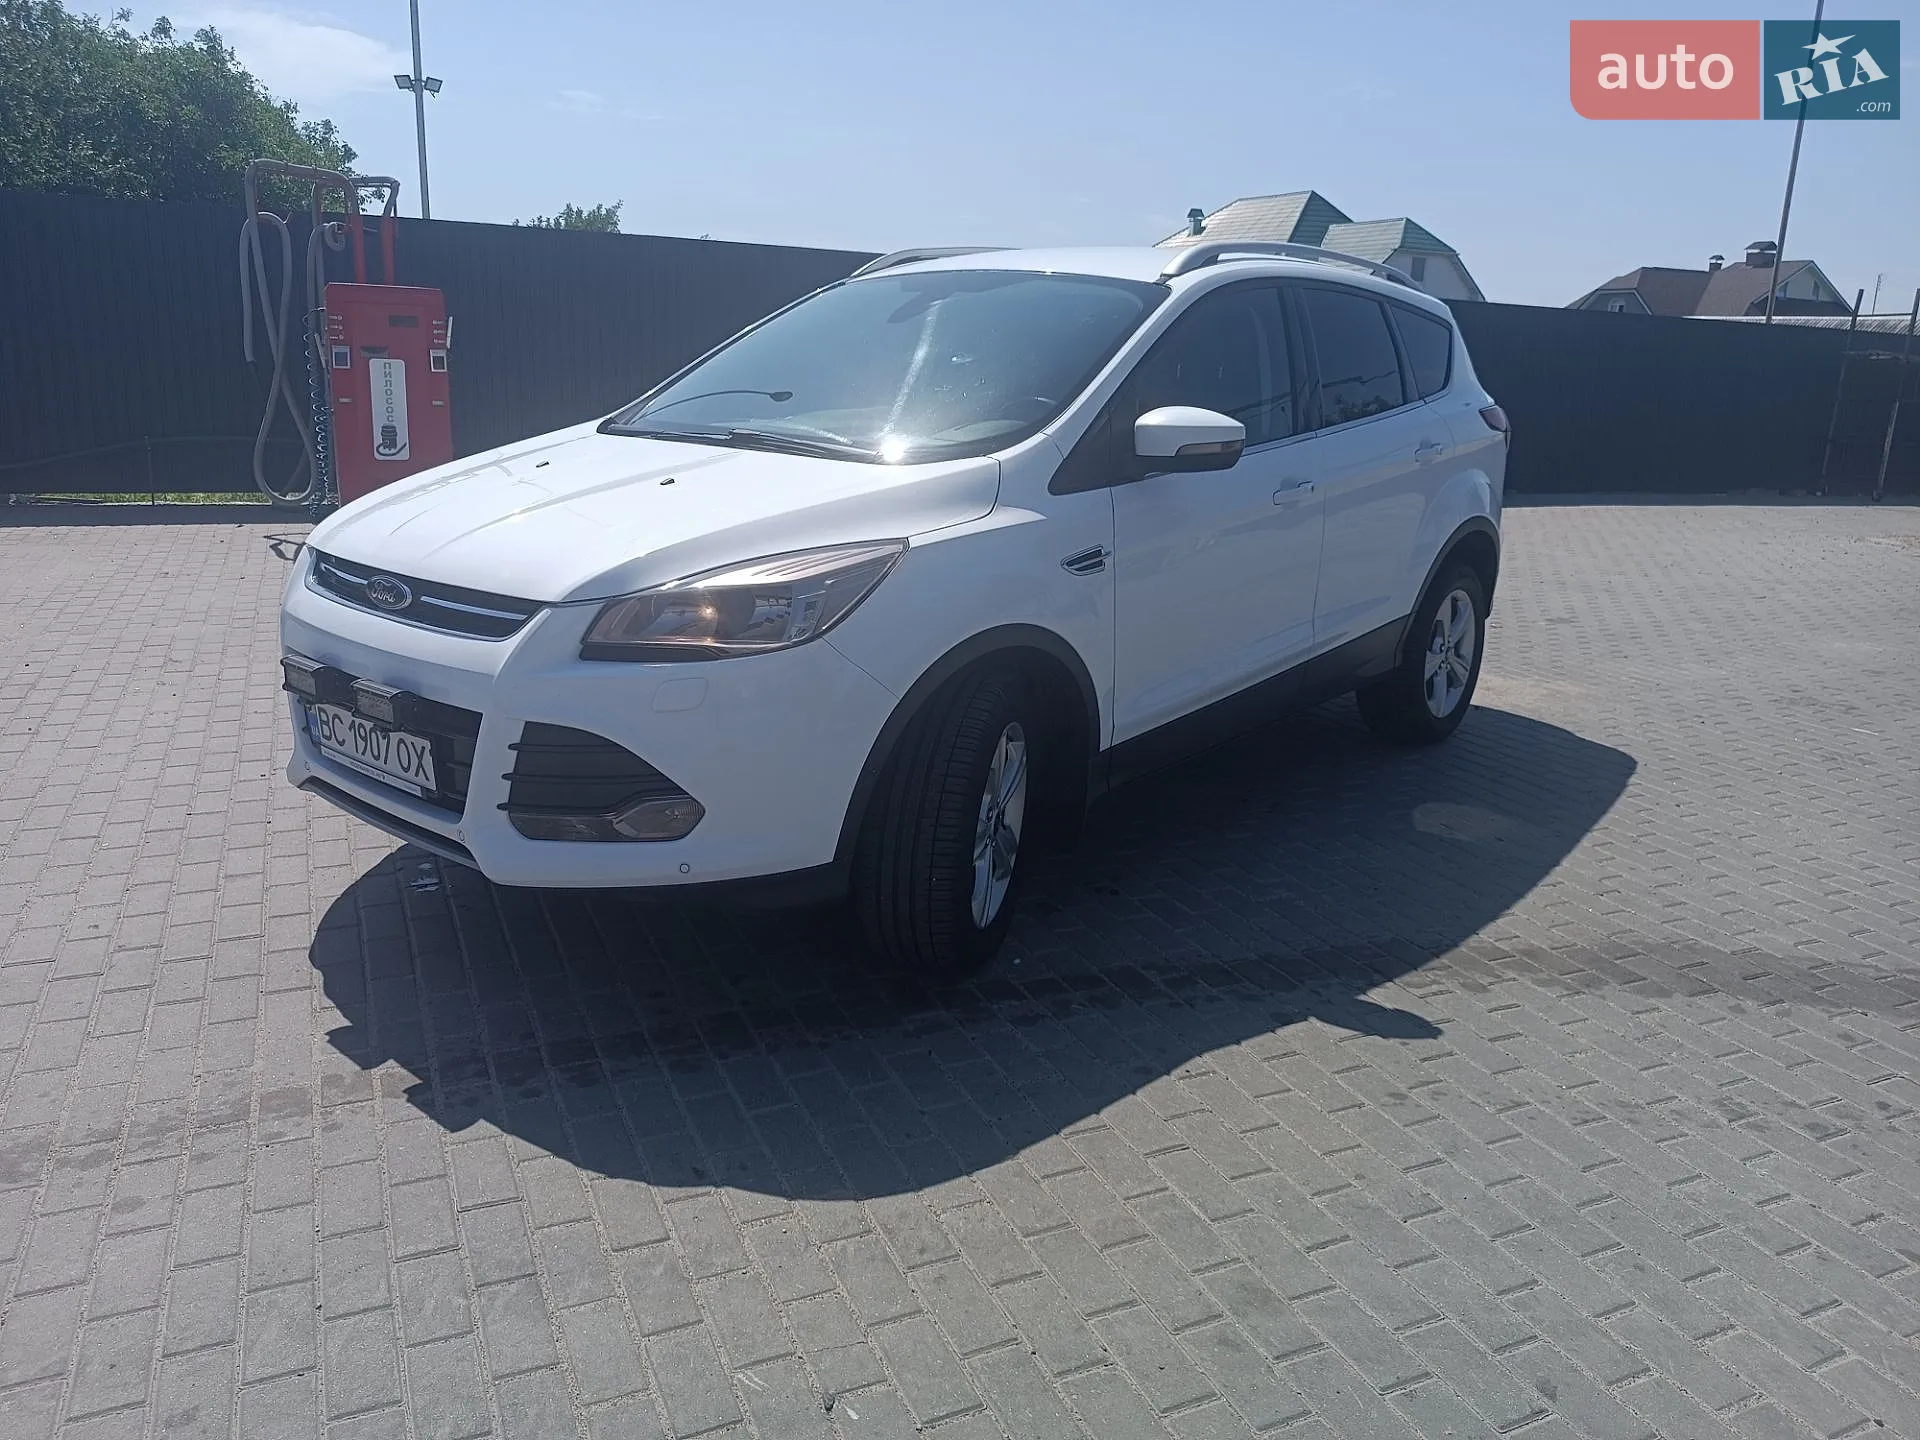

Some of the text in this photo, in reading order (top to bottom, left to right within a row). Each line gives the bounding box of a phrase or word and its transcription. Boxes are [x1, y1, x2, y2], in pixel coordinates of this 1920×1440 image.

[383, 362, 395, 423] ПИЛОСОС
[317, 706, 346, 747] BC
[348, 719, 391, 765] 1907
[397, 738, 430, 782] OX
